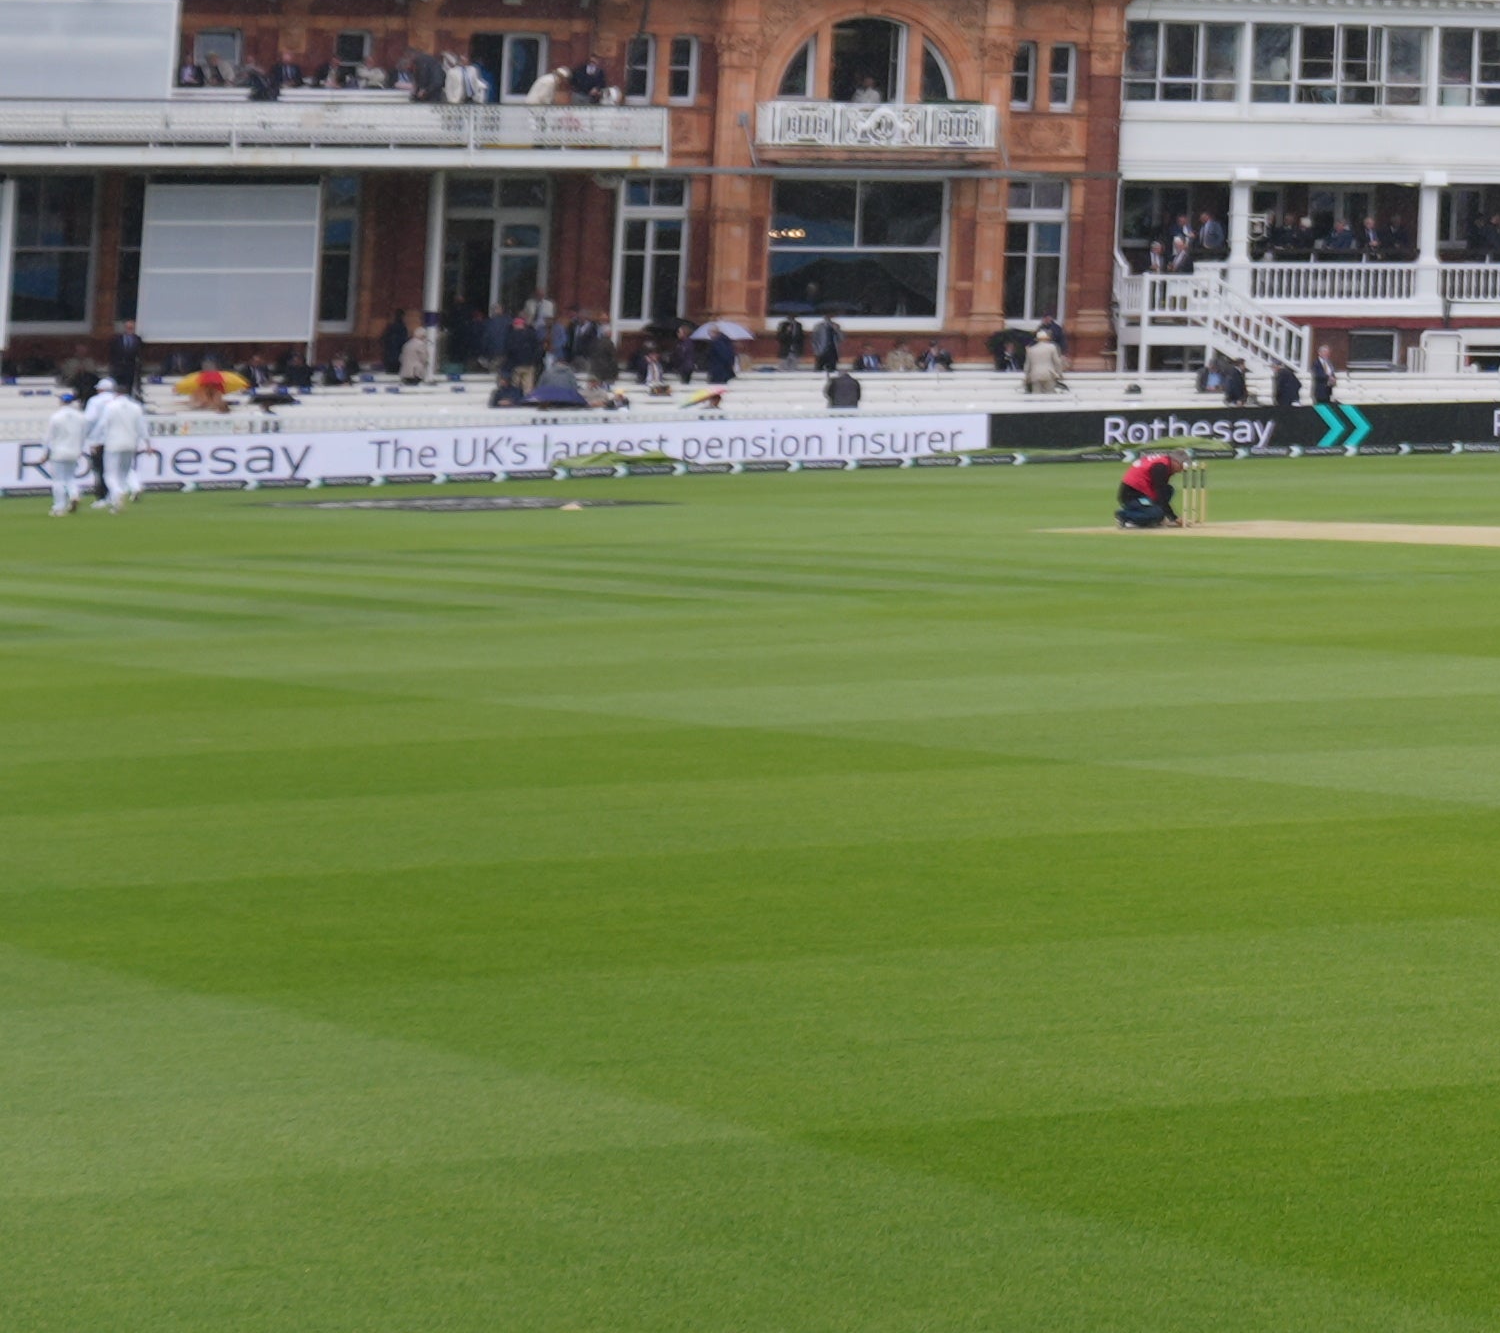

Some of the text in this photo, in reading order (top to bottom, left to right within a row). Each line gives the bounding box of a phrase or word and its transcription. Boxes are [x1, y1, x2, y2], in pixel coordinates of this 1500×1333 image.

[368, 438, 438, 469] The
[453, 436, 528, 468] UK's
[682, 428, 823, 462] pension
[838, 426, 963, 455] insurer
[1103, 414, 1275, 448] Rothesay
[16, 442, 311, 480] Resay
